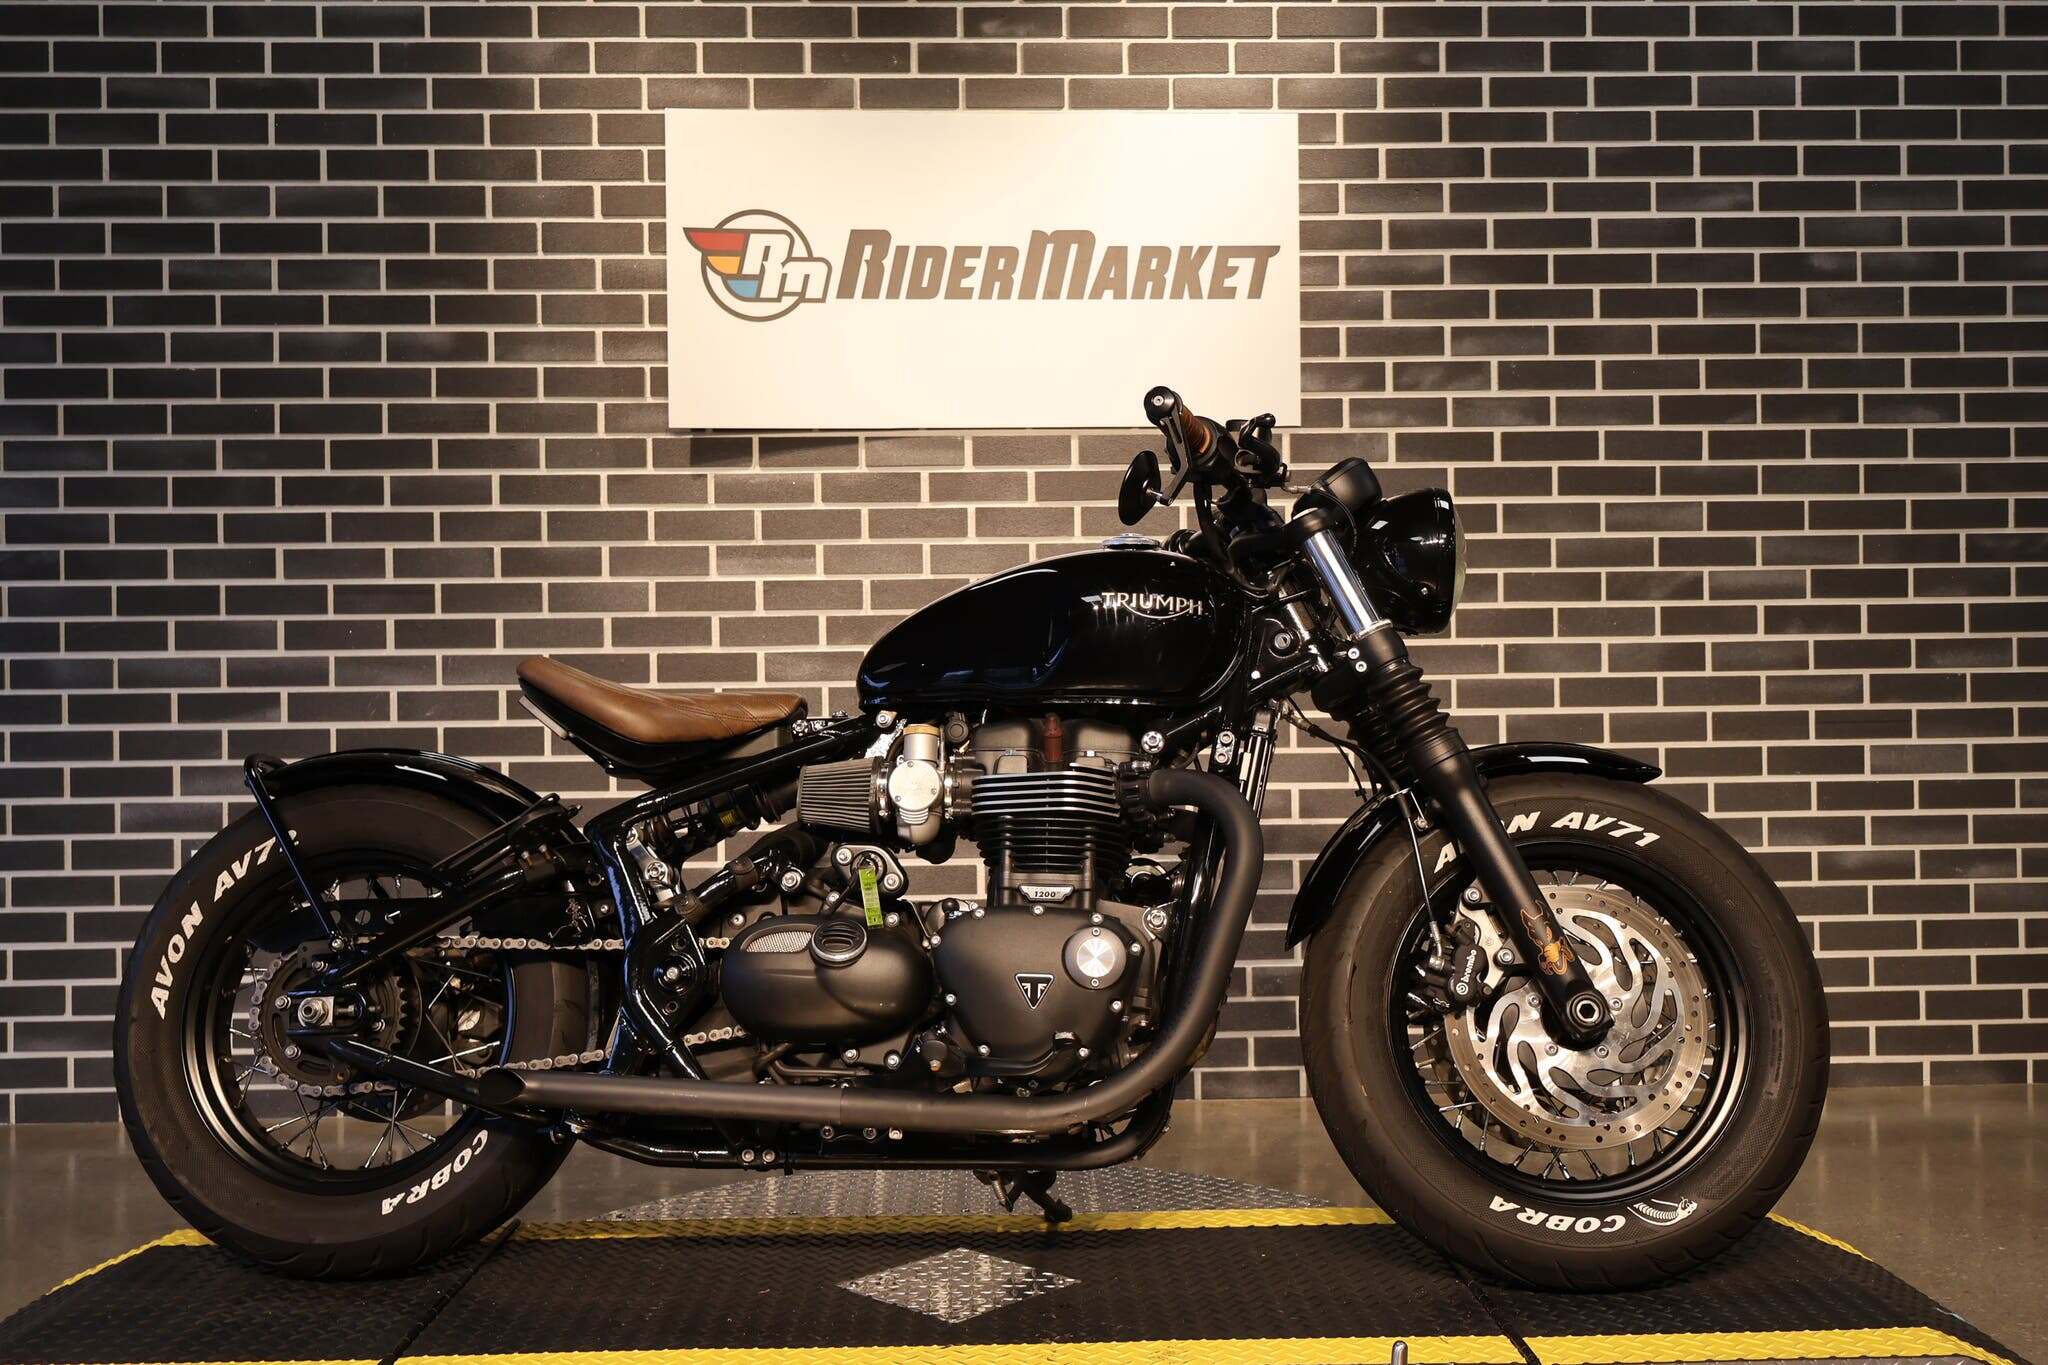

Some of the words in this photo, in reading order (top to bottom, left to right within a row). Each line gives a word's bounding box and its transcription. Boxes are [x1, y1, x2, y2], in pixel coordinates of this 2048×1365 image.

[1101, 592, 1203, 619] TRIUMPH
[1434, 811, 1541, 874] AN
[1550, 811, 1661, 847] AV71
[151, 900, 204, 1020] AVON
[1460, 949, 1477, 983] brembo
[381, 1129, 489, 1215] COBRA
[1489, 1195, 1626, 1233] COBRA
